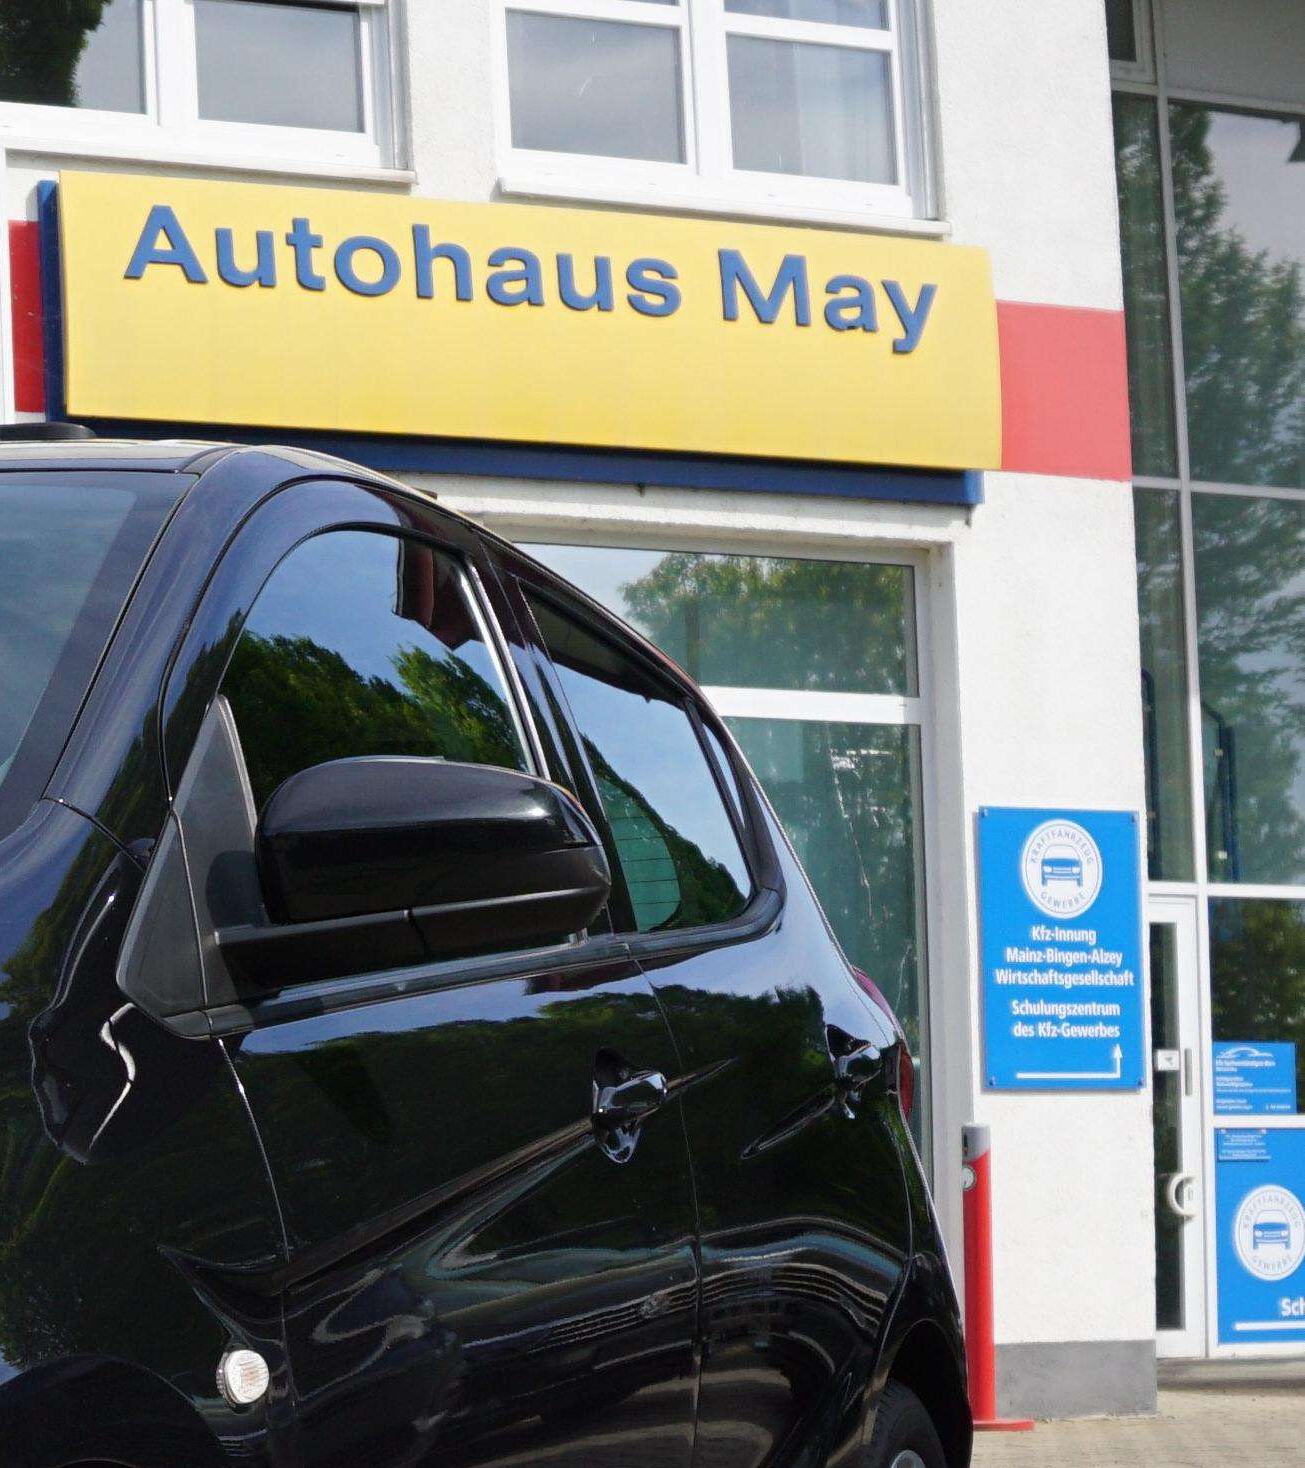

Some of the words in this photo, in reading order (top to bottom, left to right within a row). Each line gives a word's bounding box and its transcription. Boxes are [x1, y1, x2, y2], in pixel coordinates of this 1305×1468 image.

[122, 203, 683, 318] Autohaus
[717, 247, 938, 355] May
[1031, 925, 1097, 945] Kfz-Innung
[1006, 947, 1123, 968] Mainz-Bingen-Alzey
[995, 969, 1134, 989] Wirtschaftsgesellschaft
[1012, 999, 1121, 1019] Schulungszentrum
[1013, 1021, 1035, 1037] des
[1038, 1021, 1121, 1038] Kfz-Gewerbes
